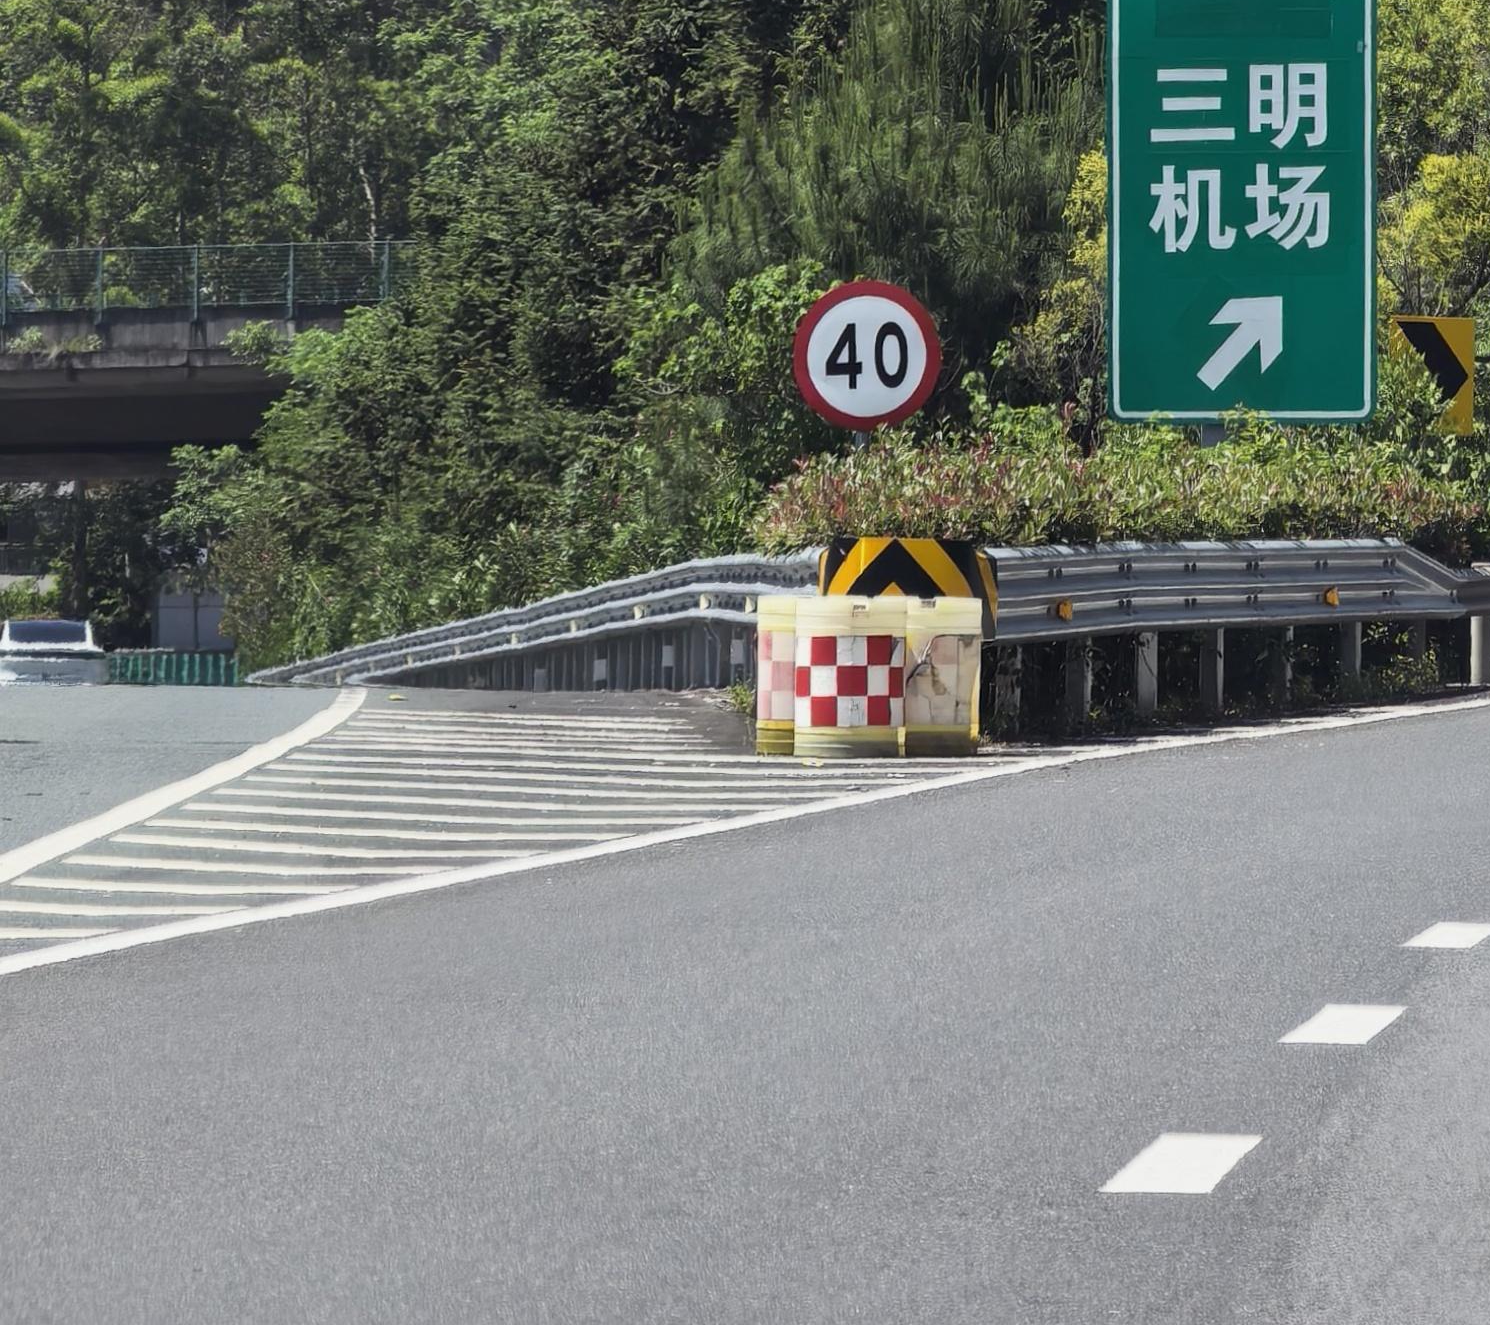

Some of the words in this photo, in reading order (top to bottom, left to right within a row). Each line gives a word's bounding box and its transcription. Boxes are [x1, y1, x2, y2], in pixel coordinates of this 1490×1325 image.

[1150, 62, 1328, 149] 三明
[1149, 162, 1331, 253] 机场
[825, 321, 909, 390] 40
